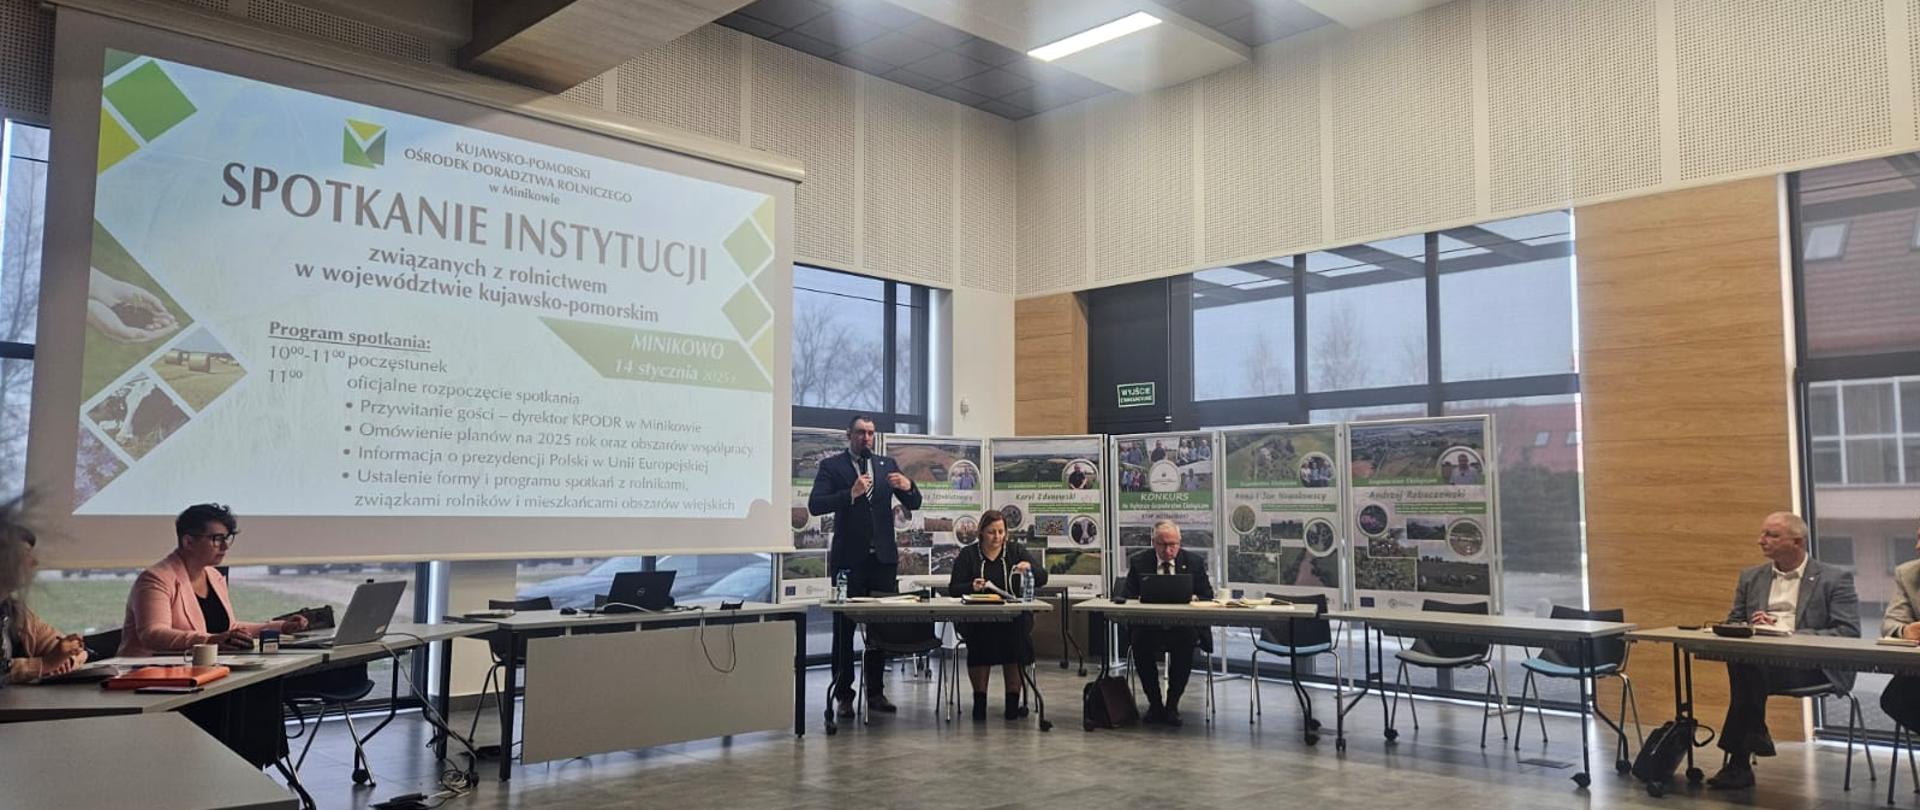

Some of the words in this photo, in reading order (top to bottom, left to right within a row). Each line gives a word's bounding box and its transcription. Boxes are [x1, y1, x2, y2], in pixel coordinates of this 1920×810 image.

[404, 148, 469, 171] OŚRODEK
[472, 162, 554, 189] DORADZTWA
[557, 179, 633, 203] ROLNICZEGO
[455, 142, 591, 180] KUJAWSKO-POMORSKI
[489, 184, 499, 193] w
[502, 184, 560, 205] Minikowie
[221, 162, 486, 245] SPOTKANIE
[504, 212, 707, 285] INSTYTUCJI
[368, 247, 485, 279] związanych
[492, 266, 503, 280] z
[509, 266, 608, 294] rolnictwem
[294, 263, 314, 278] w
[322, 265, 472, 299] województwie
[478, 283, 659, 323] kujawsko-pomorskim
[268, 321, 343, 342] Program
[348, 331, 431, 351] spotkania:
[631, 334, 724, 360] MINIKOWO
[347, 353, 447, 373] poczęstunek
[615, 358, 633, 373] 14
[638, 362, 698, 381] stycznia
[347, 374, 417, 394] oficjalne
[422, 381, 512, 401] rozpoczęcie
[516, 388, 580, 407] spotkania
[360, 400, 453, 418] Przywitanie
[457, 408, 494, 422] gości
[512, 409, 568, 426] dyrektor
[572, 414, 621, 428] KPODR
[625, 420, 636, 429] w
[640, 418, 701, 433] Minikowie
[359, 422, 452, 440] Omówienie
[457, 427, 512, 444] planów
[516, 434, 532, 445] na
[536, 432, 571, 446] 2025
[575, 434, 596, 448] rok
[600, 439, 627, 449] oraz
[631, 439, 687, 452] obszarów
[358, 446, 442, 465] Informacja
[447, 453, 458, 462] o
[462, 452, 545, 469] prezydencji
[549, 454, 588, 467] Polski
[593, 458, 603, 467] w
[608, 456, 634, 470] Unii
[639, 457, 708, 475] Europejskiej
[357, 469, 432, 485] Ustalenie
[436, 469, 480, 489] formy
[485, 472, 488, 485] i
[494, 475, 560, 491] programu
[565, 475, 614, 492] spotkań
[618, 480, 625, 489] z
[629, 479, 688, 492] rolnikami,
[354, 493, 440, 510] związkami
[445, 493, 511, 508] rolników
[516, 496, 520, 508] i
[524, 496, 617, 510] mieszkańcami
[621, 498, 679, 511] obszarów
[683, 498, 735, 512] wiejskich
[1140, 492, 1189, 502] KONKURS
